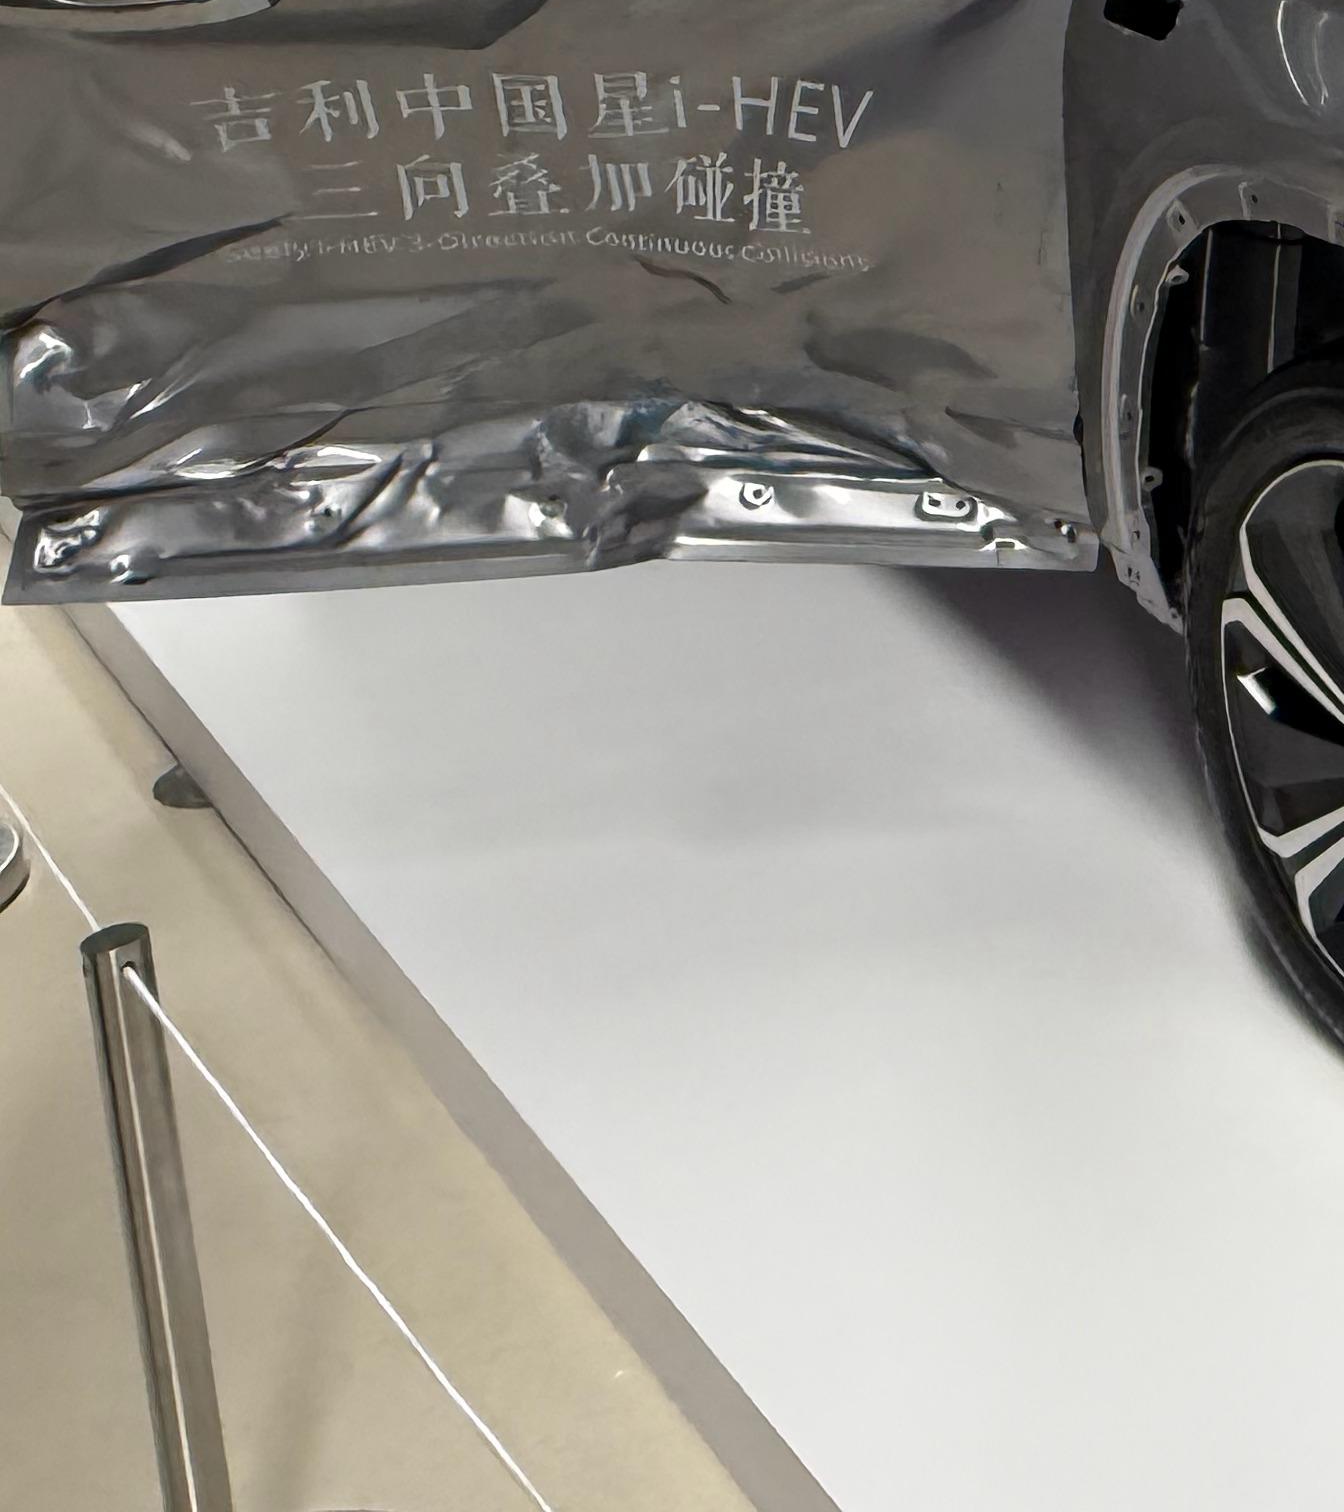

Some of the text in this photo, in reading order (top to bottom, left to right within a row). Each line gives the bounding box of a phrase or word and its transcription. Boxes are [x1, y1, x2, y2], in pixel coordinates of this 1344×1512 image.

[190, 71, 874, 152] 吉利中国星i-HEV
[288, 150, 811, 234] 三向叠加碰撞
